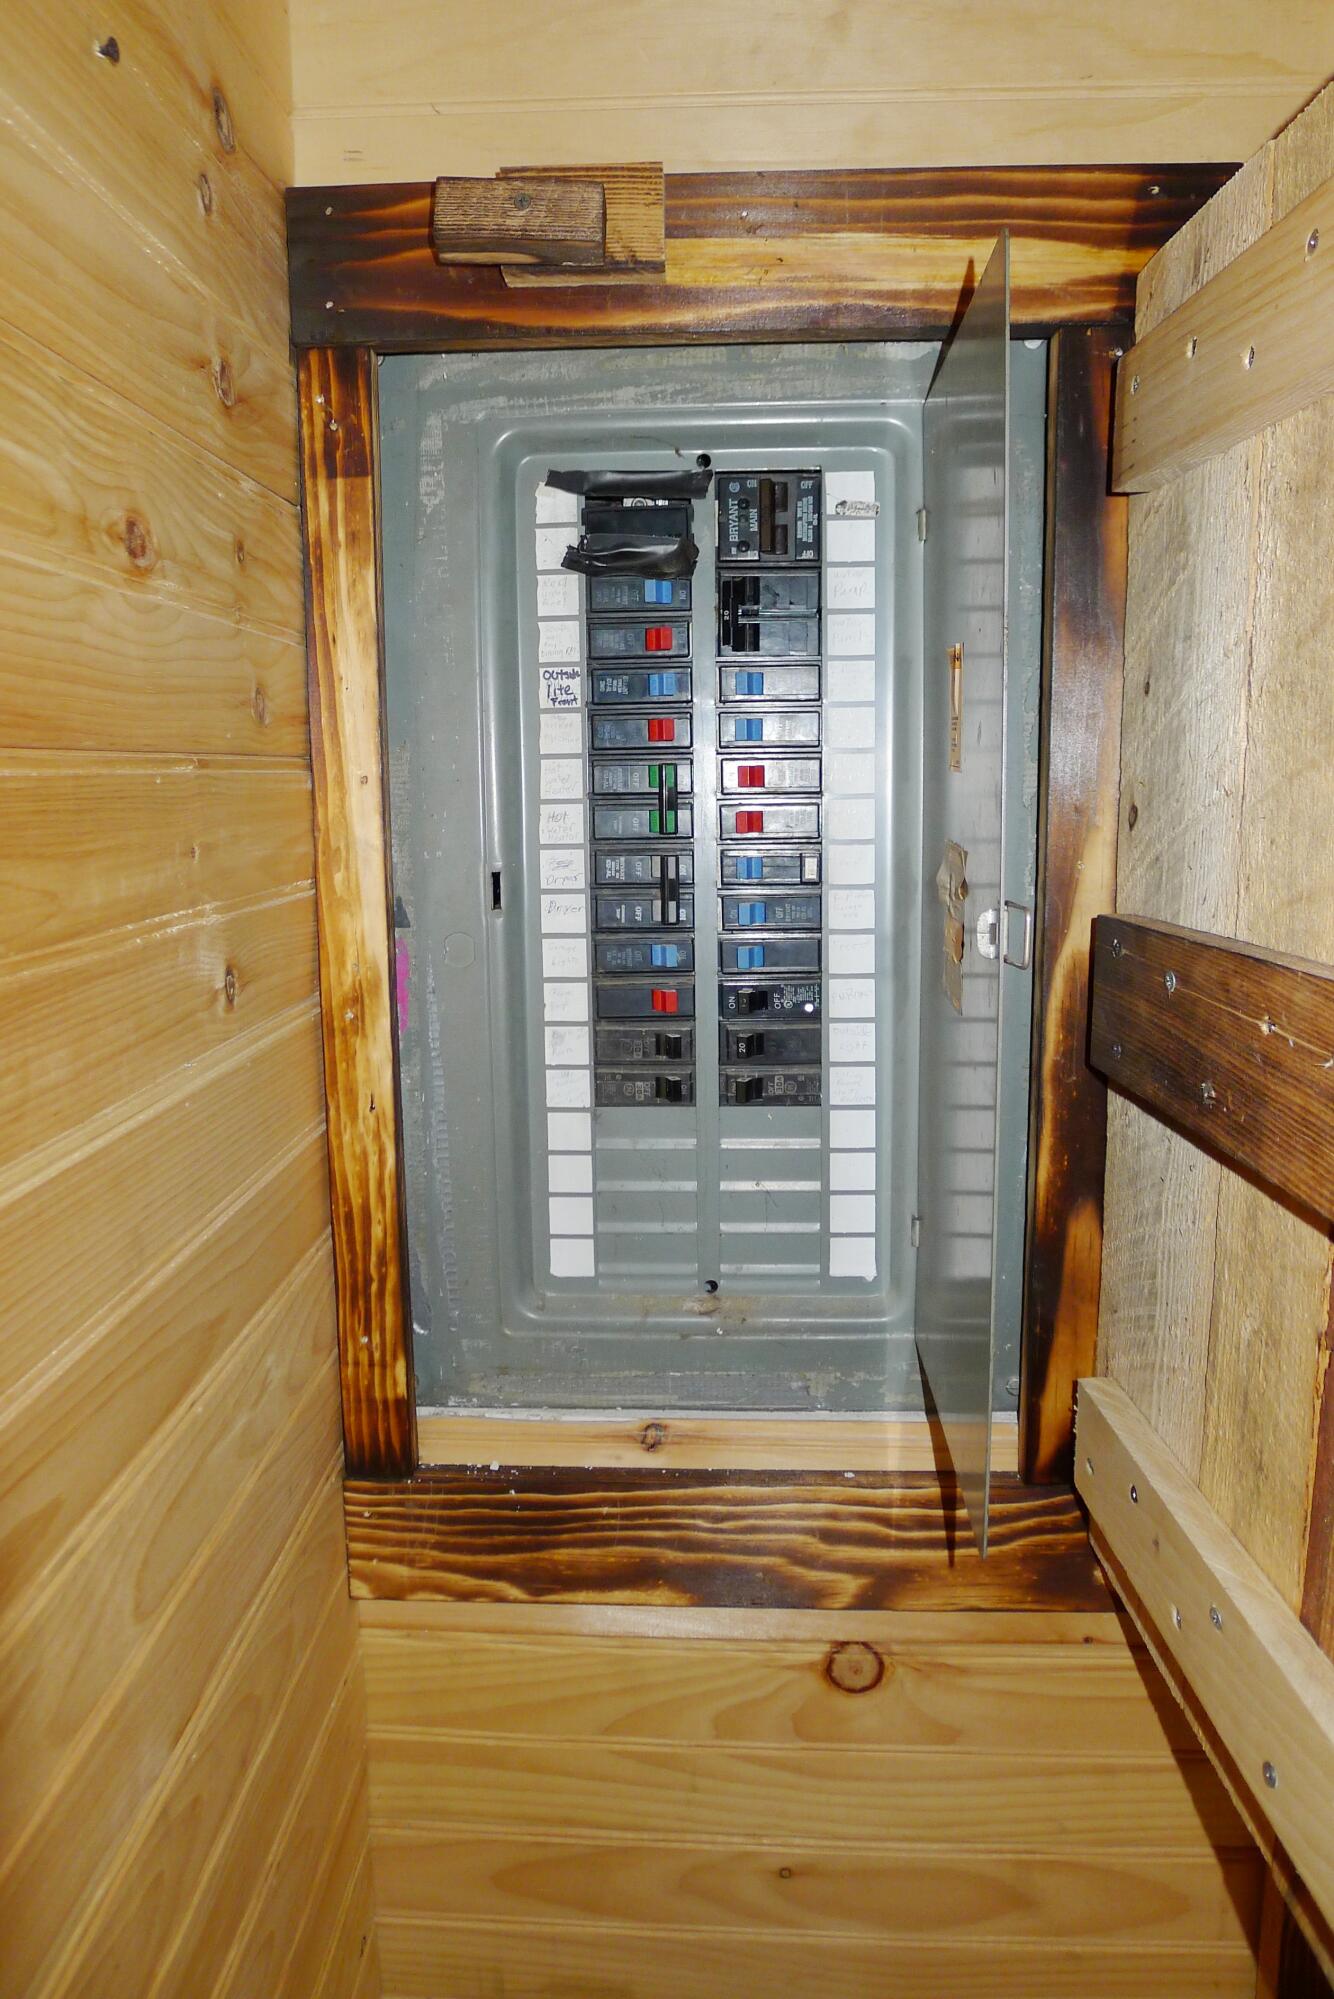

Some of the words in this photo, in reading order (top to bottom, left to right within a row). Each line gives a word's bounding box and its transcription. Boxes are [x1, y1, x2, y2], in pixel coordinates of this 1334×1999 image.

[729, 498, 739, 542] BRYANT
[749, 508, 758, 532] MAIN
[723, 609, 730, 621] 20
[634, 906, 642, 922] OFF
[679, 908, 687, 921] ON
[728, 996, 736, 1010] ON
[773, 992, 782, 1010] OFF
[738, 1042, 746, 1054] 20
